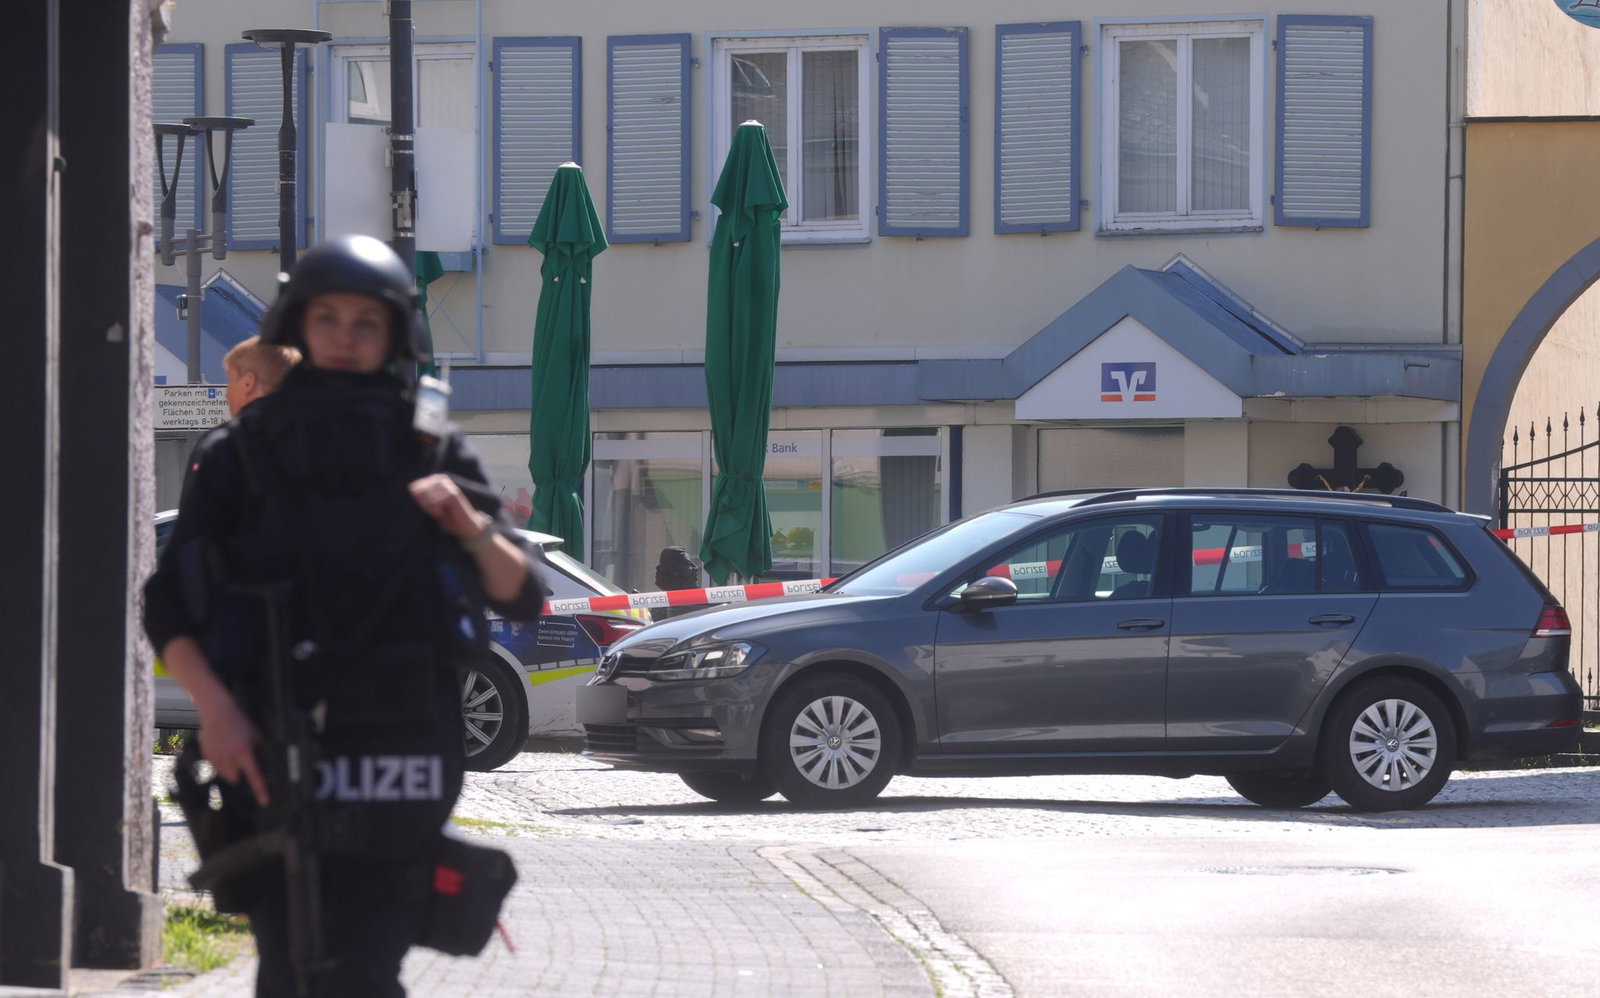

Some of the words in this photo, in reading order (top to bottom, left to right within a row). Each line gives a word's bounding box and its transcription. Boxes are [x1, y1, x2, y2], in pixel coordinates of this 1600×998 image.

[164, 389, 192, 397] Parken
[195, 389, 207, 397] mit
[216, 389, 223, 397] in
[159, 399, 229, 408] gekennzeichneten
[163, 408, 194, 416] Flächen
[196, 408, 206, 416] 30
[162, 418, 199, 426] werktags
[772, 442, 797, 453] Bank
[314, 756, 443, 800] OLIZEI
